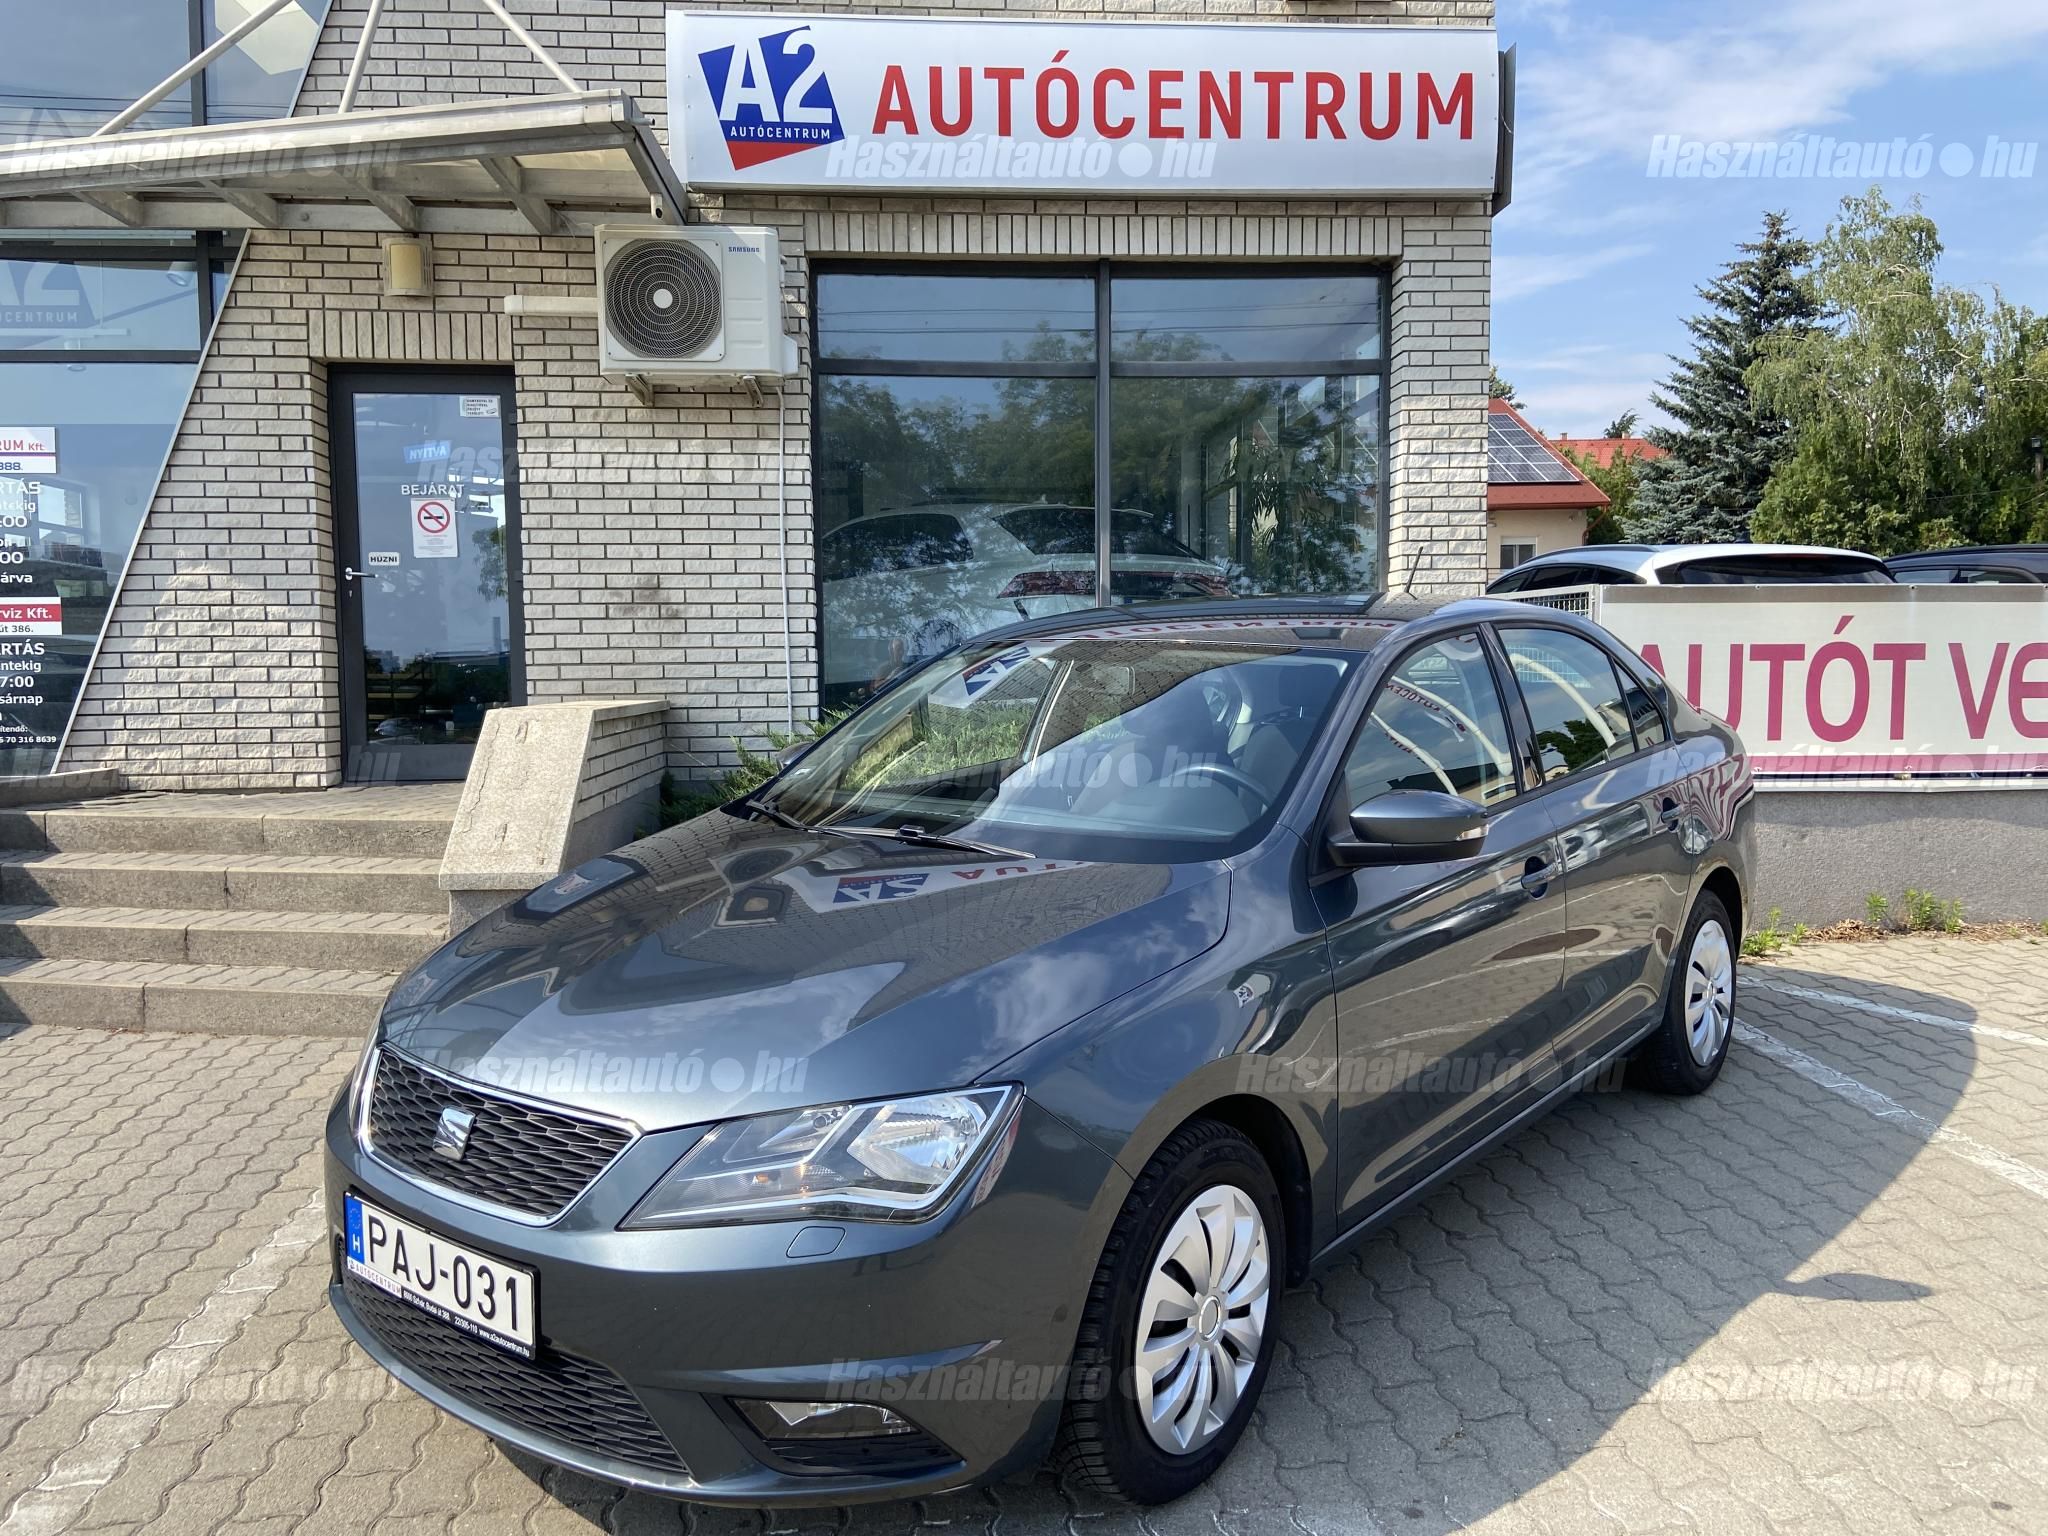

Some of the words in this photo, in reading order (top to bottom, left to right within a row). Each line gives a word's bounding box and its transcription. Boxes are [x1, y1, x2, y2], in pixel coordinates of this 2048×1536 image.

[718, 28, 833, 124] A2
[872, 50, 1474, 141] AUTÓCENTRUM
[730, 125, 831, 139] AUTÓCENTRUM
[0, 312, 78, 322] CENTRUM
[0, 440, 24, 450] UM
[401, 482, 464, 497] BEJÁRAT
[0, 608, 23, 619] viz
[27, 608, 53, 619] Kft.
[12, 625, 34, 633] 386.
[0, 639, 45, 656] RTÁS
[352, 1233, 361, 1253] H
[368, 1214, 519, 1332] PAJ-031
